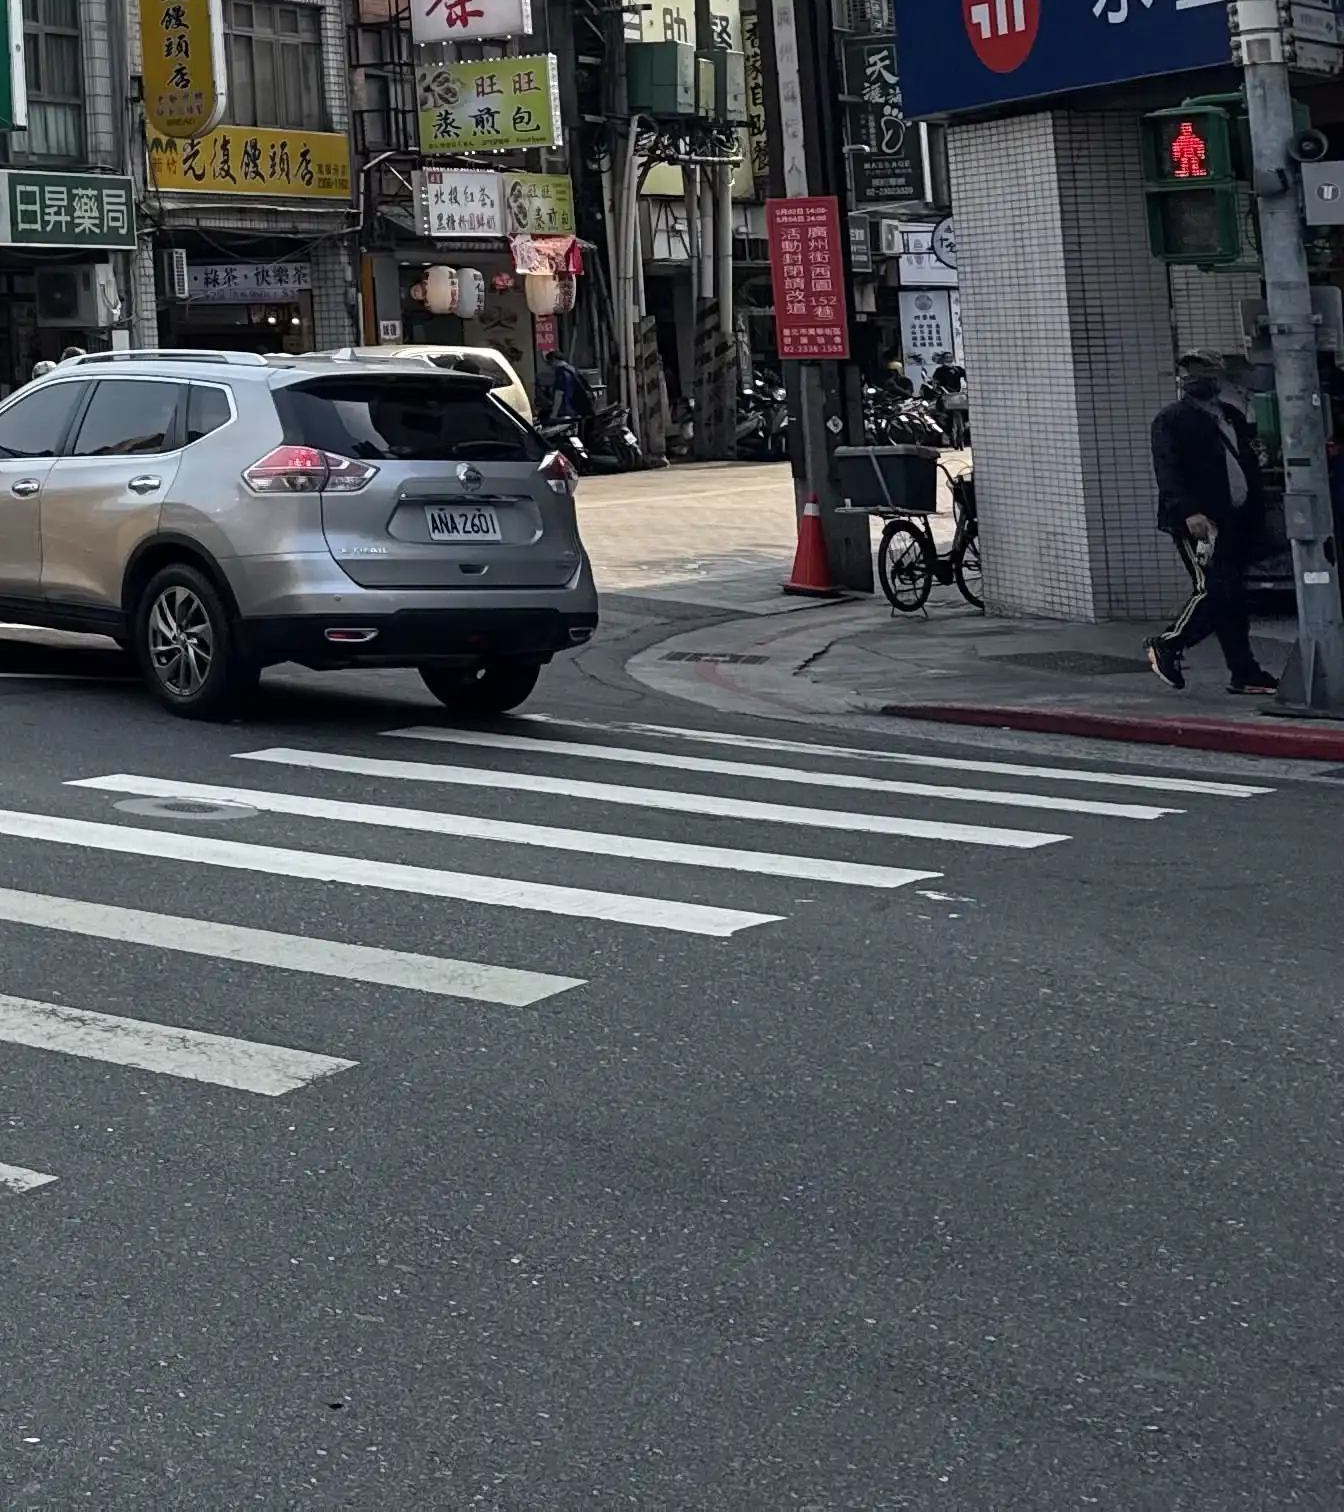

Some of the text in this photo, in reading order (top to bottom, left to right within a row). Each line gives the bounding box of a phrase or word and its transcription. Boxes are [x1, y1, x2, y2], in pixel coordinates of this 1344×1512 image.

[474, 70, 542, 98] 旺旺
[432, 106, 541, 139] 蒸煎包
[16, 183, 128, 236] 日昇藥局
